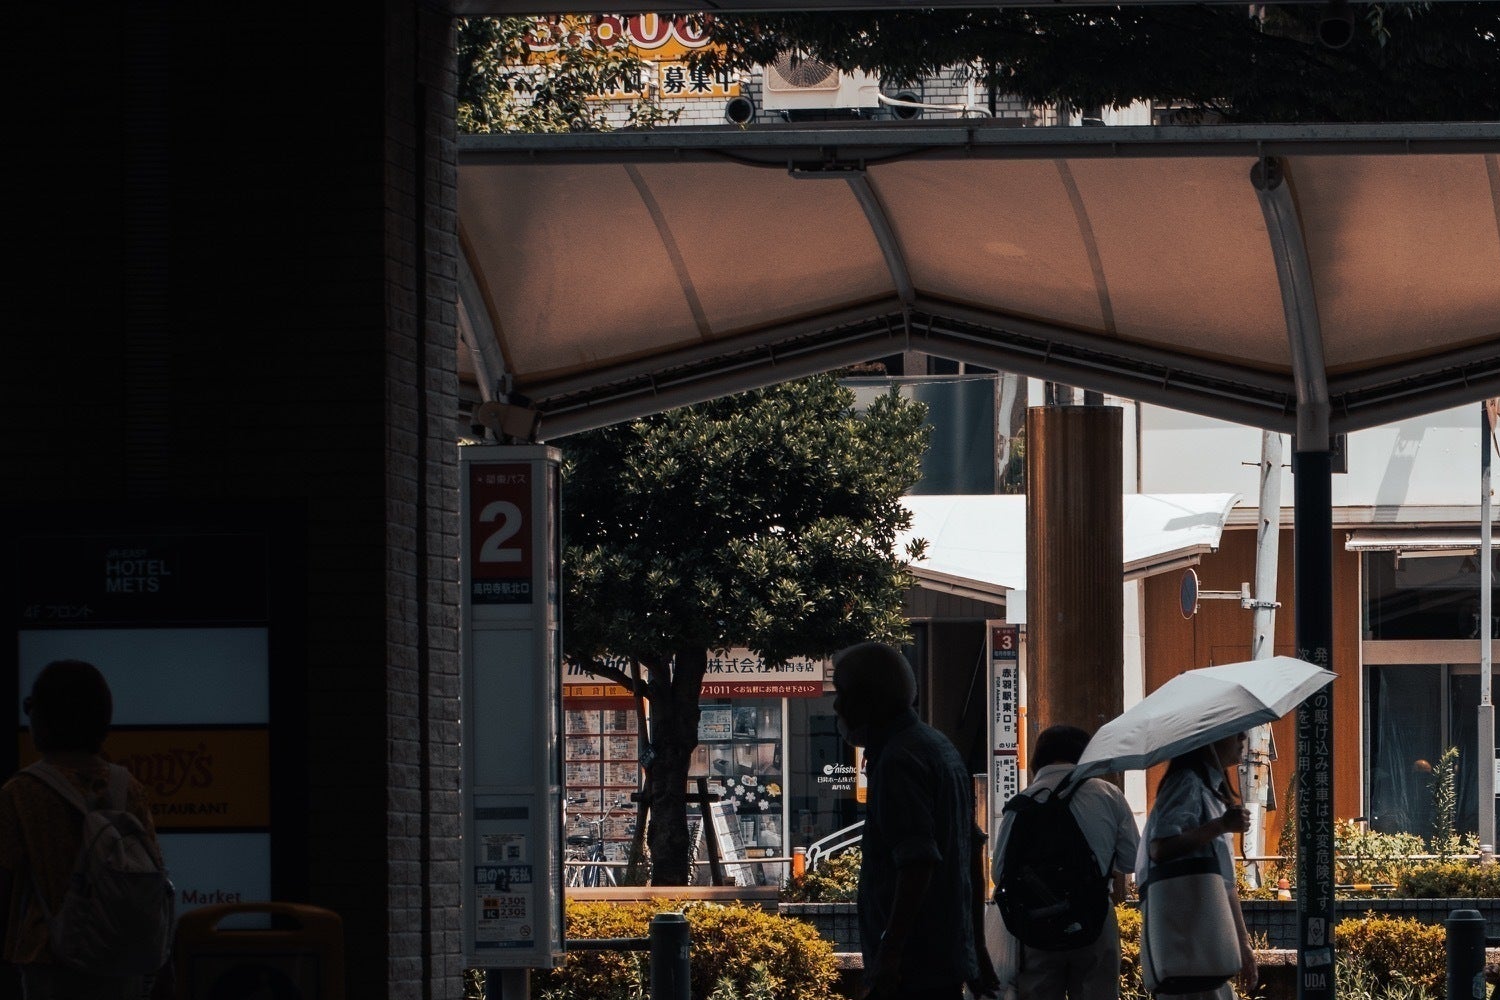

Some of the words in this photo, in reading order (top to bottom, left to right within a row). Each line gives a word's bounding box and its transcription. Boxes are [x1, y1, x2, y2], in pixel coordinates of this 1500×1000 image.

[663, 66, 735, 93] 募集中
[479, 500, 522, 563] 2
[105, 560, 171, 576] HOTEL
[105, 577, 160, 593] METS
[473, 583, 529, 594] 高円寺駅北口
[1002, 635, 1012, 650] 3
[708, 658, 771, 674] 株式会社
[1298, 648, 1311, 840] 次をご利用ください。
[1314, 647, 1329, 913] 発の駆け込み乗車は大変危険です。
[151, 803, 229, 815] STAURANT
[182, 890, 241, 904] Market
